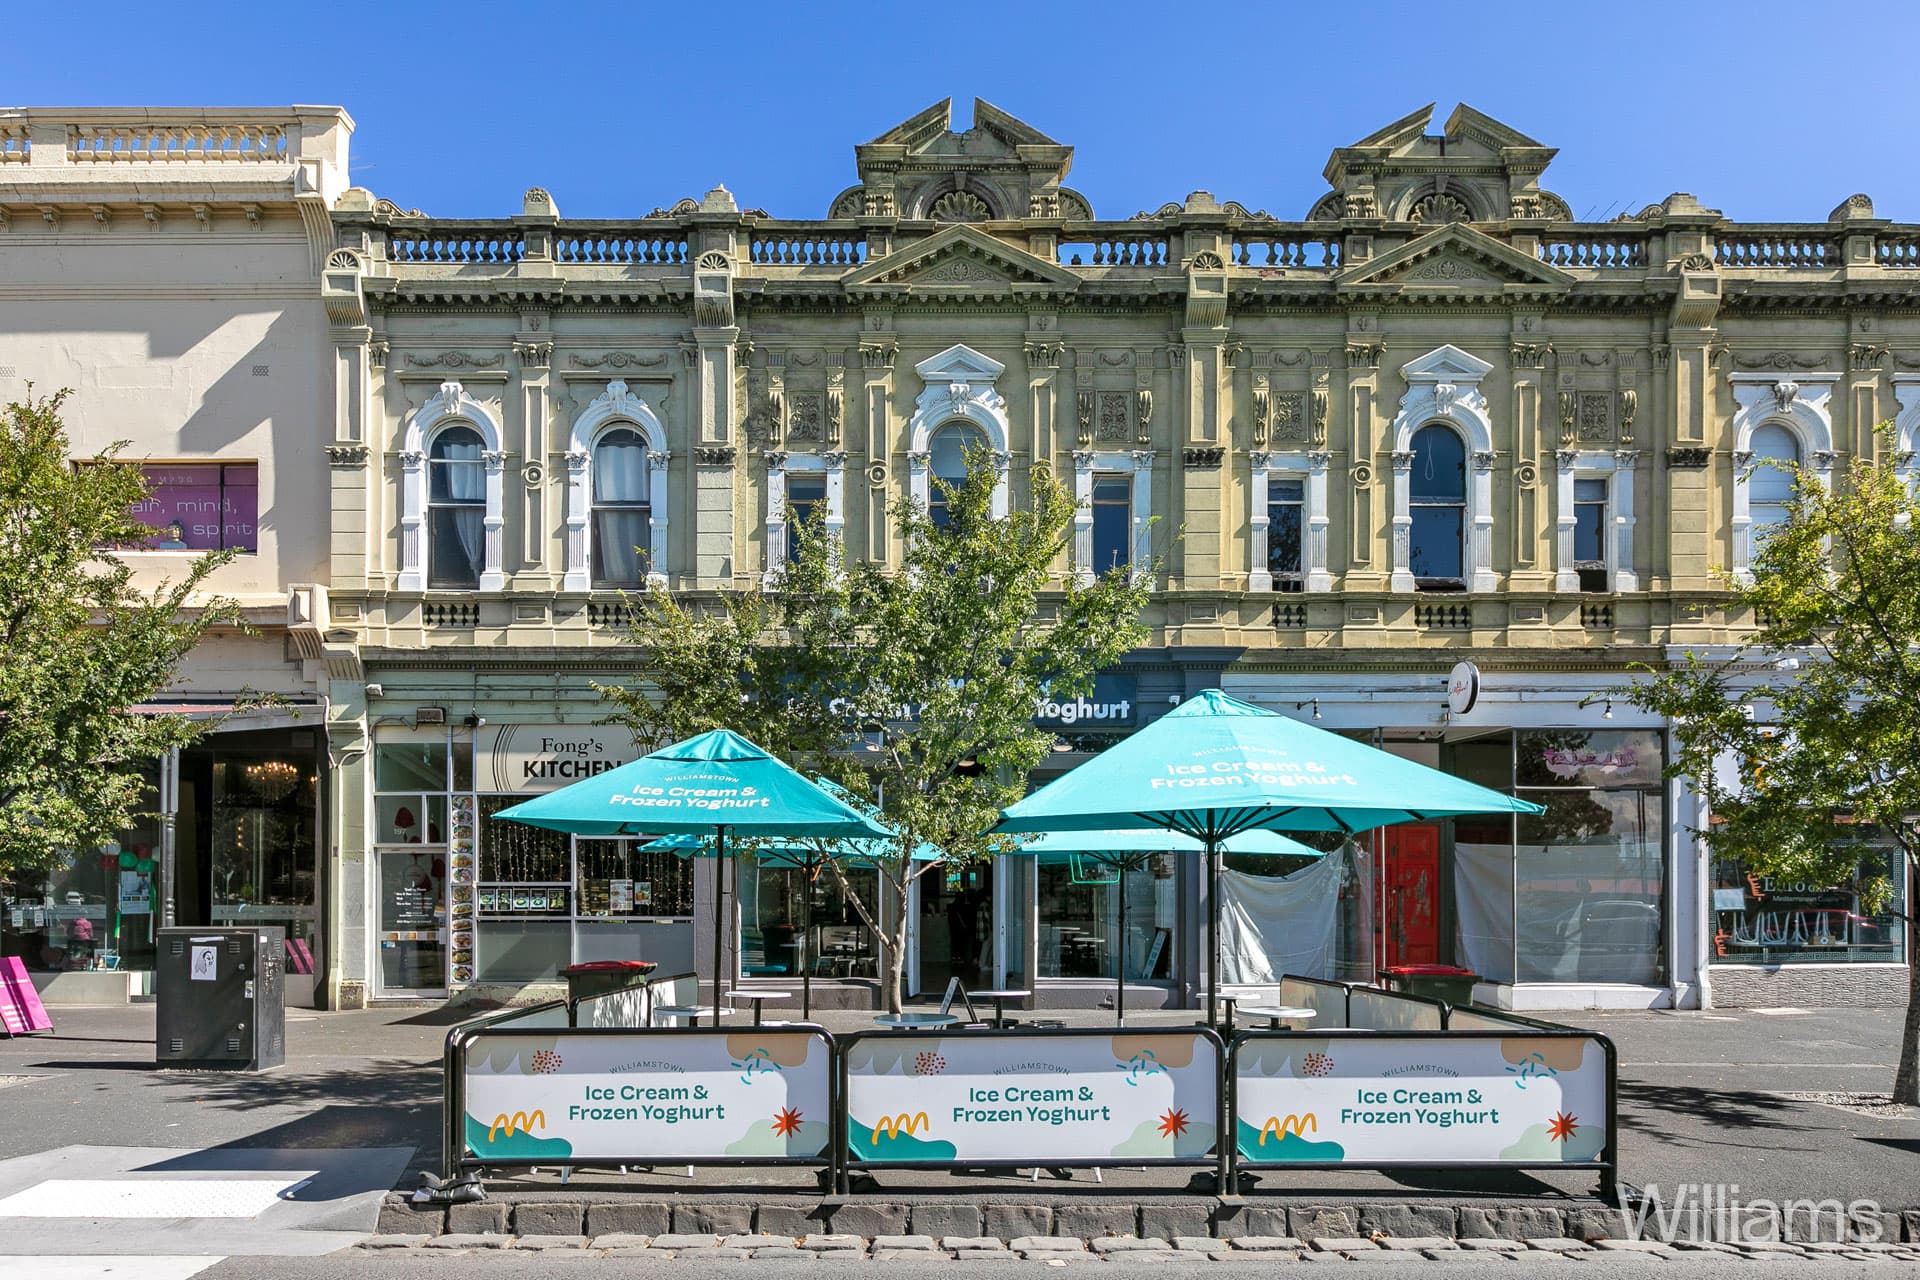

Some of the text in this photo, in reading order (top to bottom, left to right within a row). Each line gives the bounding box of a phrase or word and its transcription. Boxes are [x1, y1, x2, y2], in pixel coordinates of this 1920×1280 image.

[130, 498, 238, 514] air, mind,
[192, 521, 252, 538] sprit
[1033, 694, 1130, 724] Yoghurt
[1167, 761, 1327, 775] Ice Cream &
[664, 774, 739, 784] WILLIAMSTOWN
[1150, 773, 1357, 789] Frozen Yoghurt
[632, 784, 756, 797] Ice Cream &
[609, 794, 770, 810] Frozen Yoghurt
[609, 1061, 685, 1074] WILLIAMSTOWN
[993, 1062, 1071, 1076] WILLIAMSTOWN
[1382, 1064, 1460, 1078] WILLIAMSTOWN
[585, 1085, 708, 1100] Ice Cream &
[969, 1086, 1093, 1102] Ice Cream &
[1357, 1089, 1482, 1104] Ice Cream &
[569, 1104, 725, 1124] Frozen Yoghurt
[953, 1105, 1110, 1125] Frozen Yoghurt
[1341, 1108, 1499, 1128] Frozen Yoghurt
